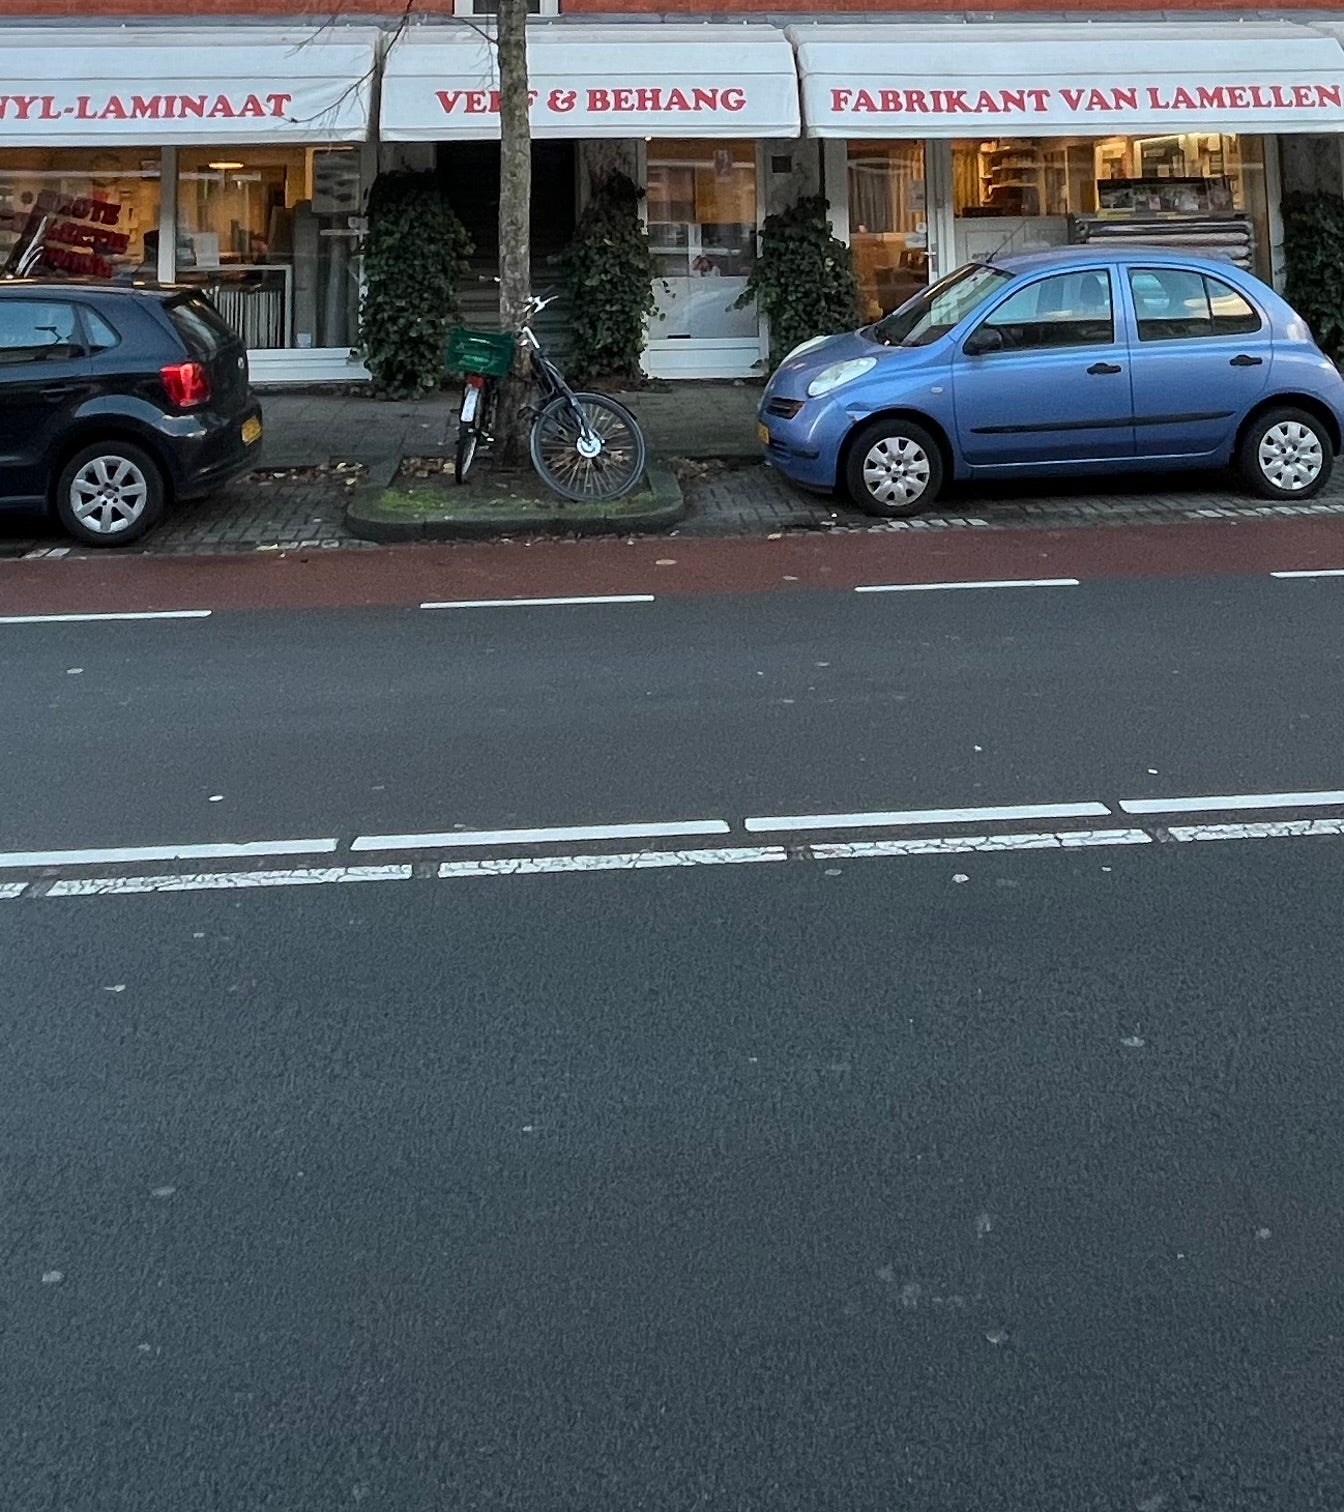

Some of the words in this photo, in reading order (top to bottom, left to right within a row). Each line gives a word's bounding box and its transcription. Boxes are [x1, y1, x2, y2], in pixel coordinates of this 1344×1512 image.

[546, 88, 578, 113] &
[586, 87, 747, 112] BEHANG
[830, 88, 1052, 114] FABRIKANT
[1058, 87, 1139, 112] VAN
[1148, 84, 1343, 110] LAMELLEN
